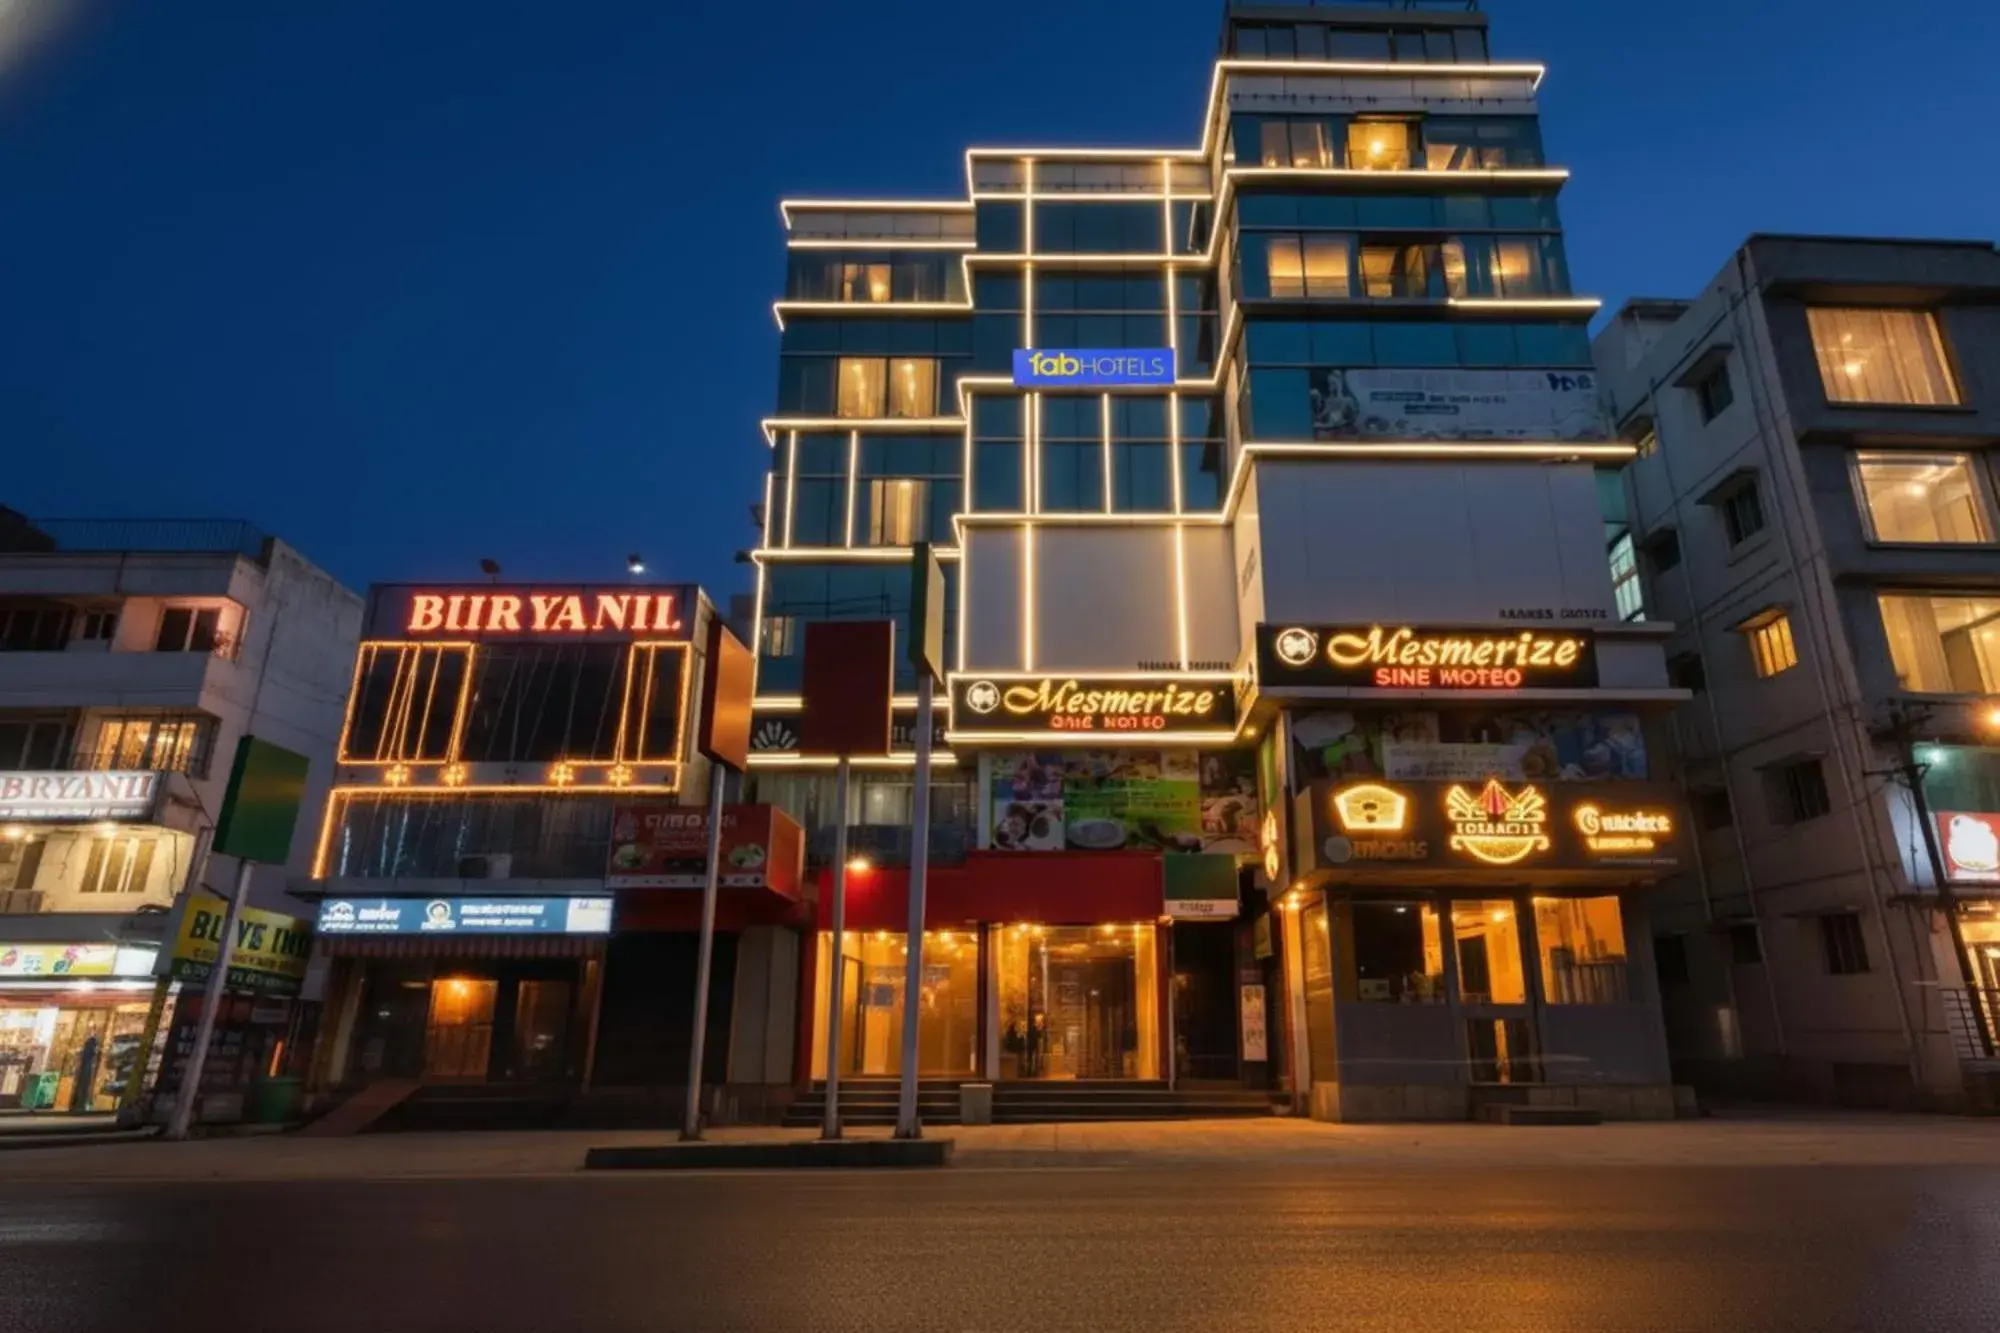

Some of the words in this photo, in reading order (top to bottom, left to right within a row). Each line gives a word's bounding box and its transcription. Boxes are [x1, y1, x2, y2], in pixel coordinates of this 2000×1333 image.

[1029, 352, 1165, 377] fabHOTELS
[1326, 624, 1580, 667] Mesmerize
[1375, 667, 1431, 686] SINE
[1003, 678, 1214, 715] Mesmerize
